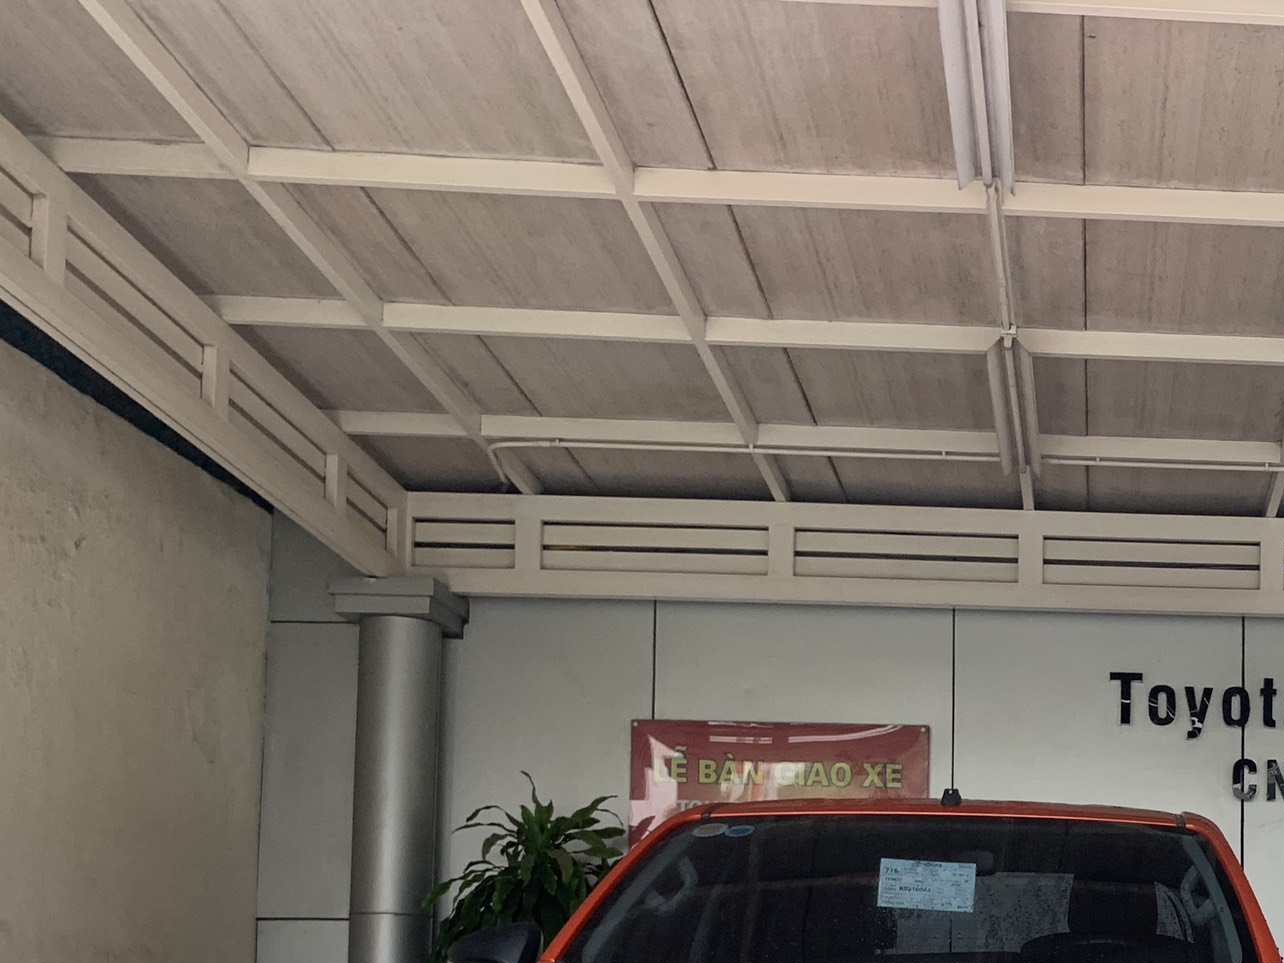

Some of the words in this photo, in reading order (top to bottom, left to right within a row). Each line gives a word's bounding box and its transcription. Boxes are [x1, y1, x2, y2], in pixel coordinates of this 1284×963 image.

[652, 745, 688, 784] LỄ
[698, 753, 764, 786] BÀN
[774, 761, 853, 787] GIAO
[862, 763, 903, 788] XE
